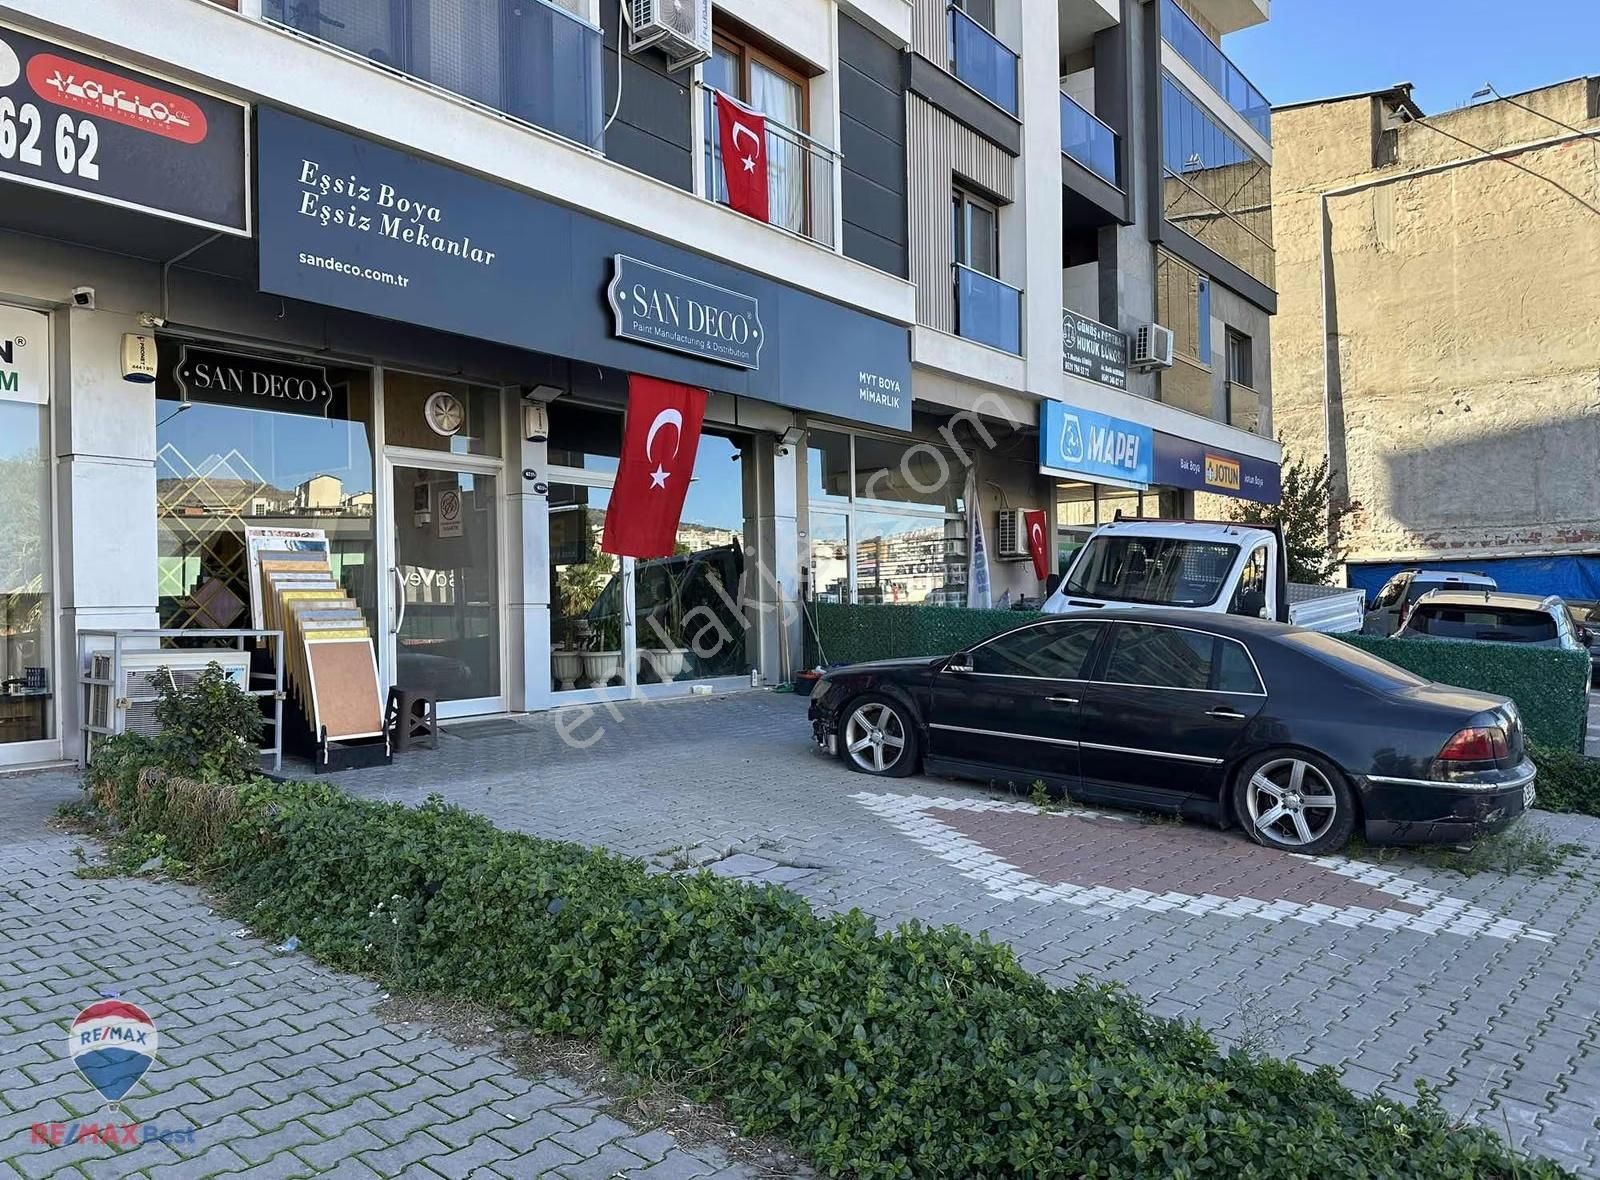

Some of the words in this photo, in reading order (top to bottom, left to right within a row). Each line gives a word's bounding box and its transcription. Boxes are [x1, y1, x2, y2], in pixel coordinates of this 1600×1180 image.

[55, 113, 99, 181] 62
[298, 159, 371, 202] Eşsiz
[377, 183, 442, 223] Boya
[298, 190, 371, 232] Eşsiz
[378, 213, 496, 266] Mekanlar
[299, 251, 409, 288] sandeco.com.tr
[632, 283, 680, 328] SAN
[633, 320, 652, 335] Paint
[653, 327, 705, 350] Manufacturing
[706, 340, 711, 350] &
[713, 341, 750, 359] Distribution
[1076, 335, 1101, 357] HUKUK
[194, 363, 244, 392] SAN
[252, 371, 317, 402] DECO
[859, 371, 877, 386] MYT
[879, 376, 901, 392] BOYA
[859, 387, 900, 409] MİMARLIK
[1087, 425, 1140, 470] MAPEI
[1214, 464, 1239, 485] JOTUN
